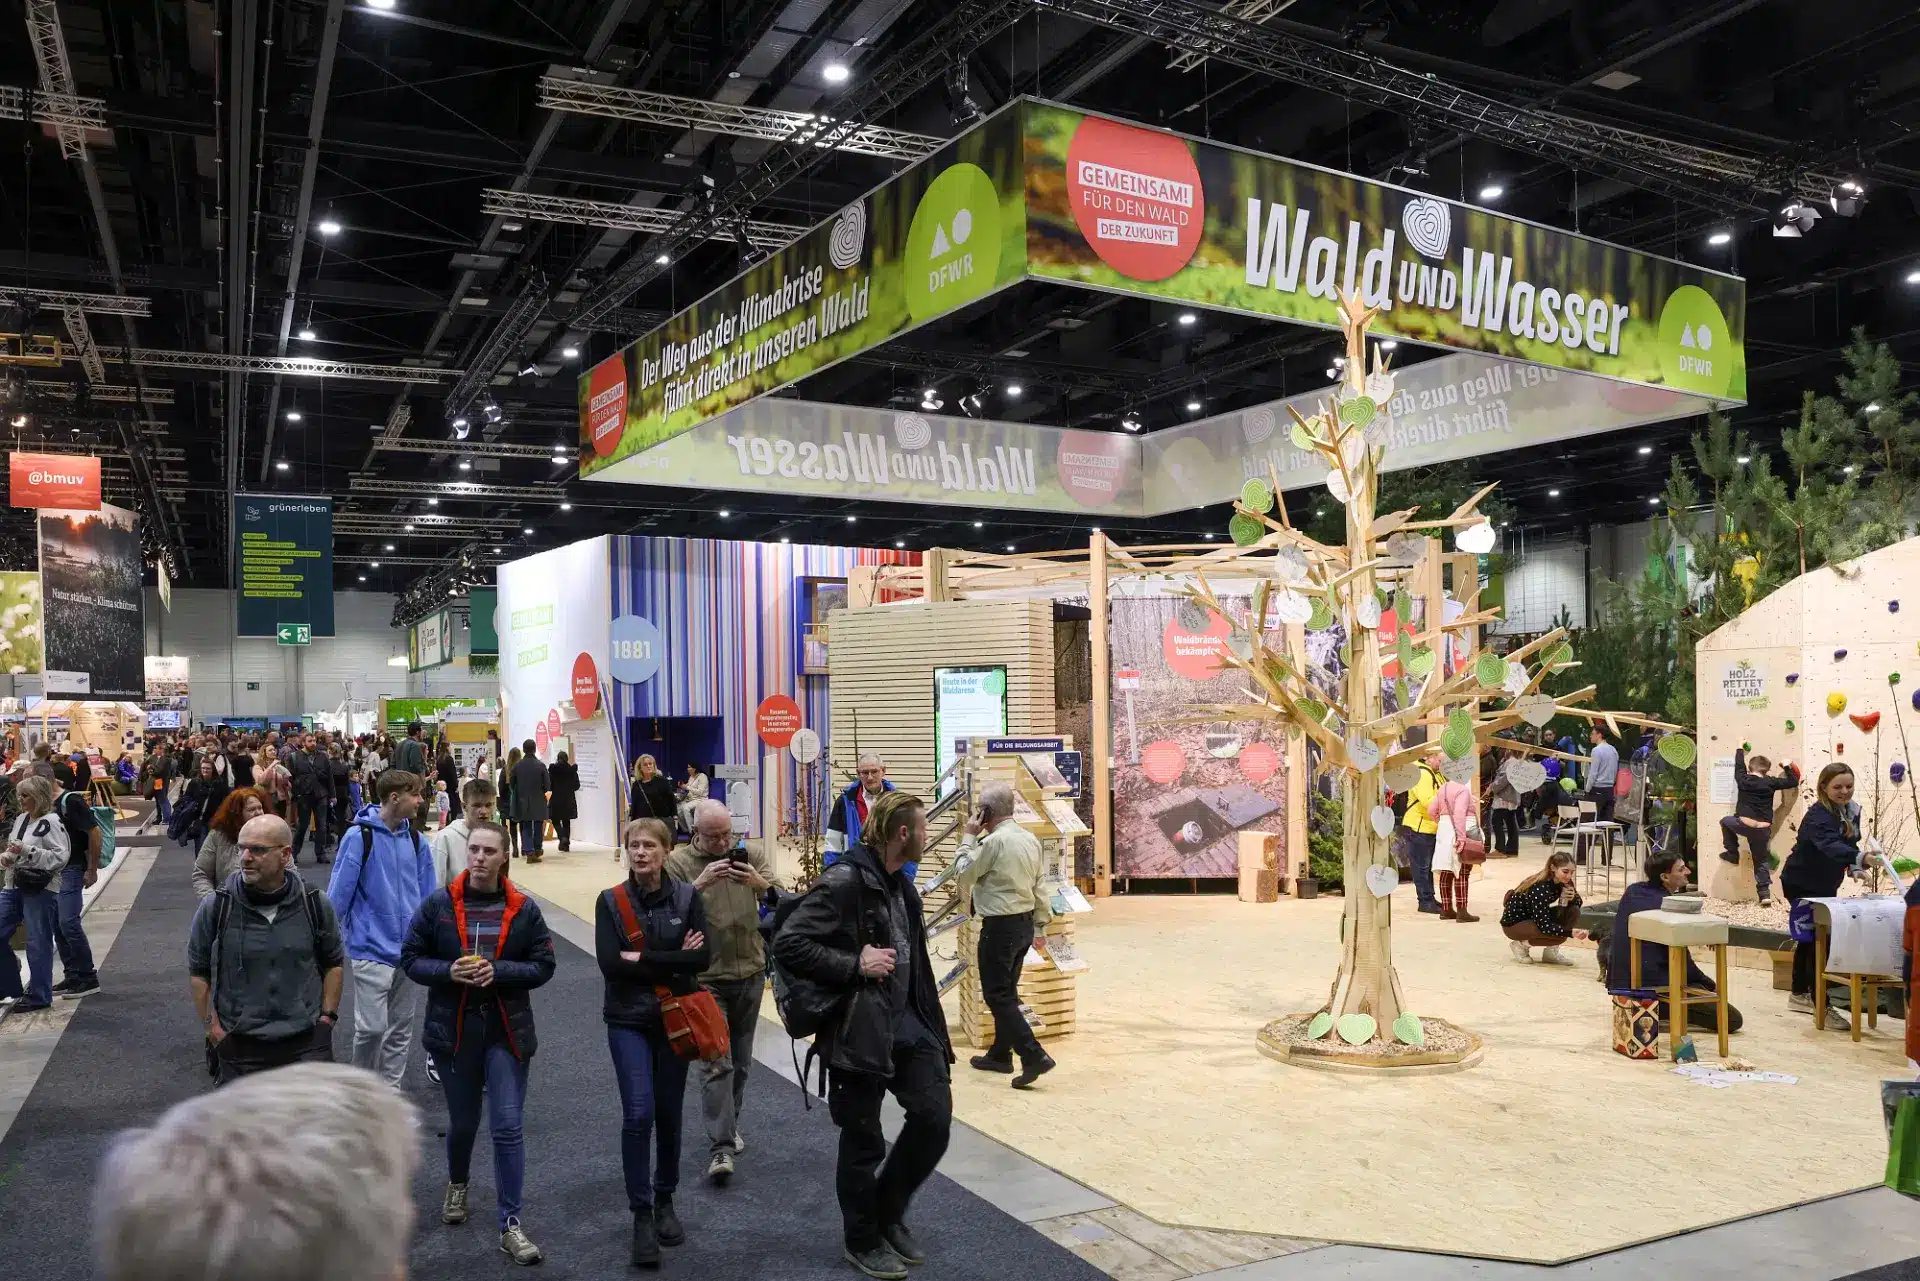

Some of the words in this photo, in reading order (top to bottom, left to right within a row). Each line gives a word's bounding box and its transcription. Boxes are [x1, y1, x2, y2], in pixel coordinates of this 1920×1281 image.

[1082, 165, 1188, 204] GEMEINSAM!
[1083, 189, 1112, 211] FÜR
[1116, 198, 1145, 218] DEN
[1148, 204, 1189, 226] WALD
[1101, 223, 1122, 237] DER
[1125, 225, 1175, 242] ZUKUNFT
[929, 252, 974, 293] DFWR
[1245, 197, 1397, 310] Wald
[1398, 257, 1457, 311] UND
[1462, 246, 1630, 356] Wasser
[641, 357, 661, 391] Der
[661, 341, 688, 377] Weg
[689, 328, 712, 364] aus
[714, 312, 738, 350] der
[739, 264, 823, 337] Klimakrise
[661, 376, 695, 424] führt
[695, 355, 736, 401] direkt
[737, 344, 751, 380] in
[754, 314, 817, 372] unseren
[821, 275, 870, 339] Wald
[1678, 355, 1713, 377] DFWR
[591, 383, 624, 410] GEMEINSAM!
[28, 470, 84, 485] @bmuv
[269, 503, 327, 513] grünerleben
[52, 588, 70, 601] Natur
[97, 595, 114, 608] Klima
[611, 639, 652, 660] 1881
[942, 677, 960, 686] Heute
[961, 677, 967, 685] in
[967, 677, 978, 685] der
[1723, 679, 1764, 689] RETTET
[1729, 669, 1757, 679] HOLZ
[942, 686, 976, 694] Waldarena
[1726, 688, 1760, 698] KLIMA
